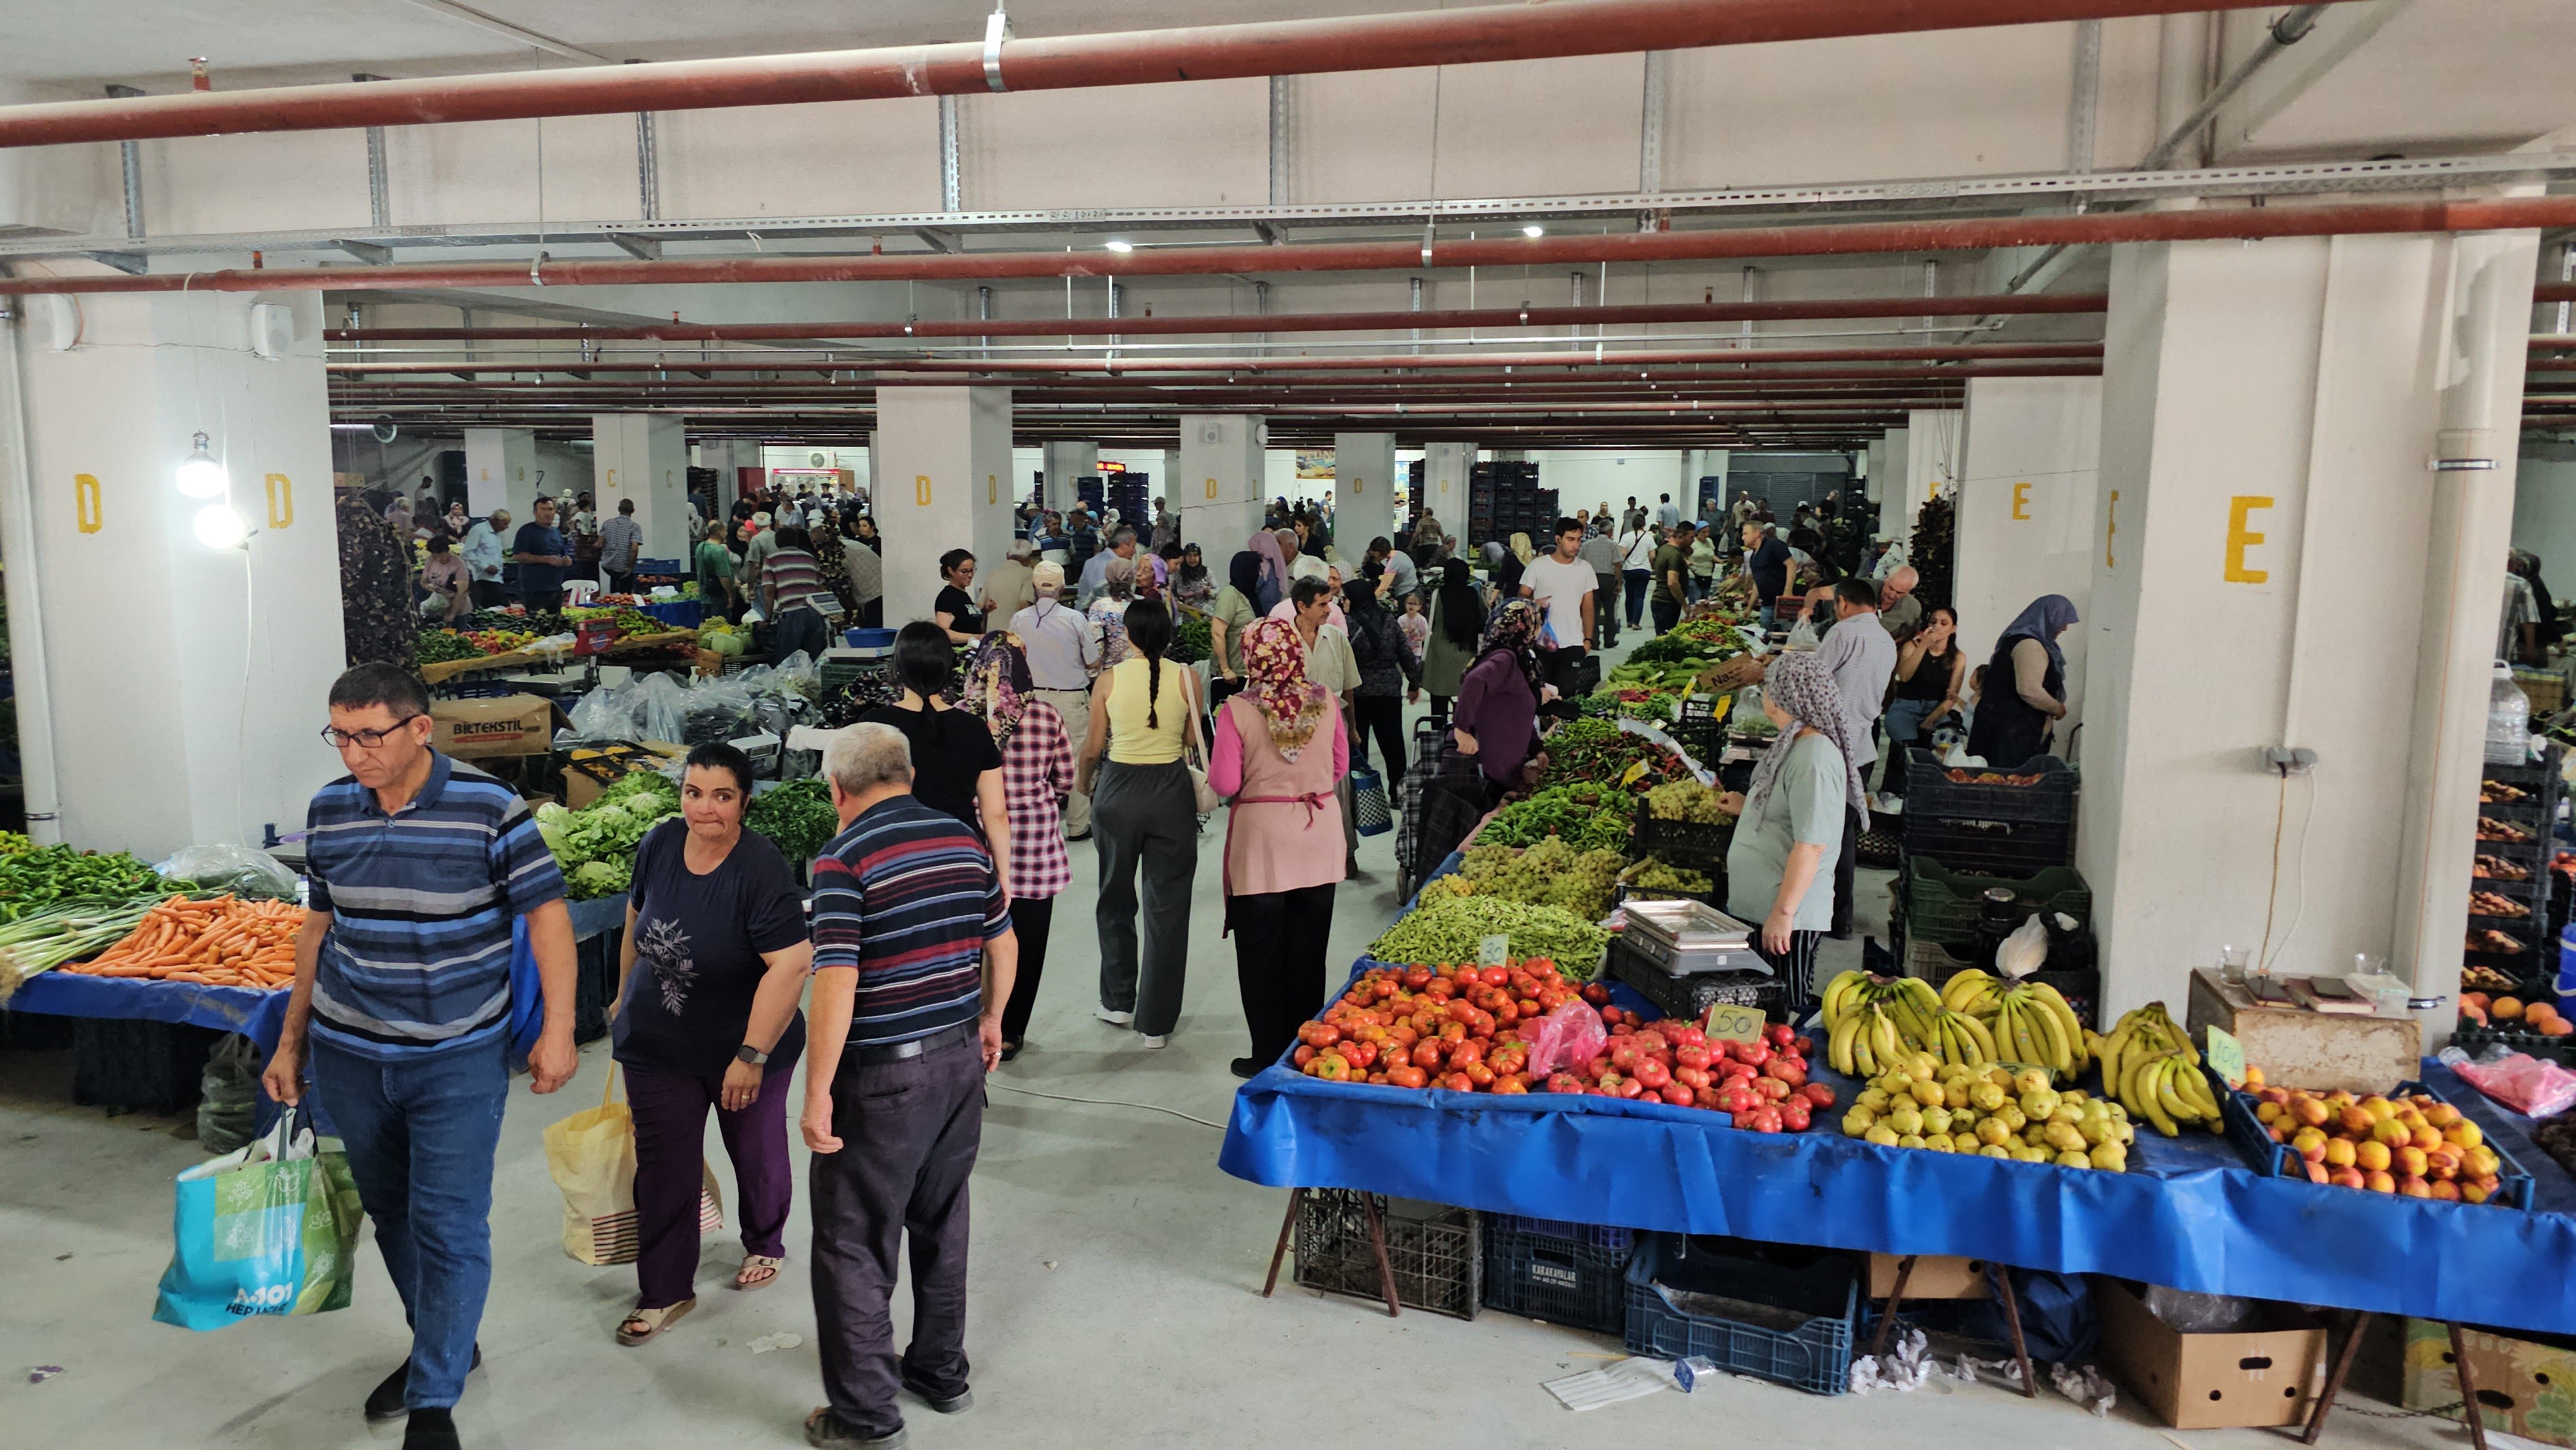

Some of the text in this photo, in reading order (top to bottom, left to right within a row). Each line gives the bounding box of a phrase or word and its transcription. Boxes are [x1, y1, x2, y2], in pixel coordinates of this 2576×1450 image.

[607, 469, 616, 487] C
[916, 475, 932, 505] D
[1206, 478, 1217, 500] D
[1354, 478, 1362, 493] D
[75, 473, 102, 533] D
[265, 473, 293, 528] D
[2013, 483, 2032, 520] E
[2224, 496, 2274, 583] E
[1484, 942, 1503, 963] 30
[1715, 1010, 1752, 1034] 50
[1532, 1264, 1577, 1282] KARAKAYALAR
